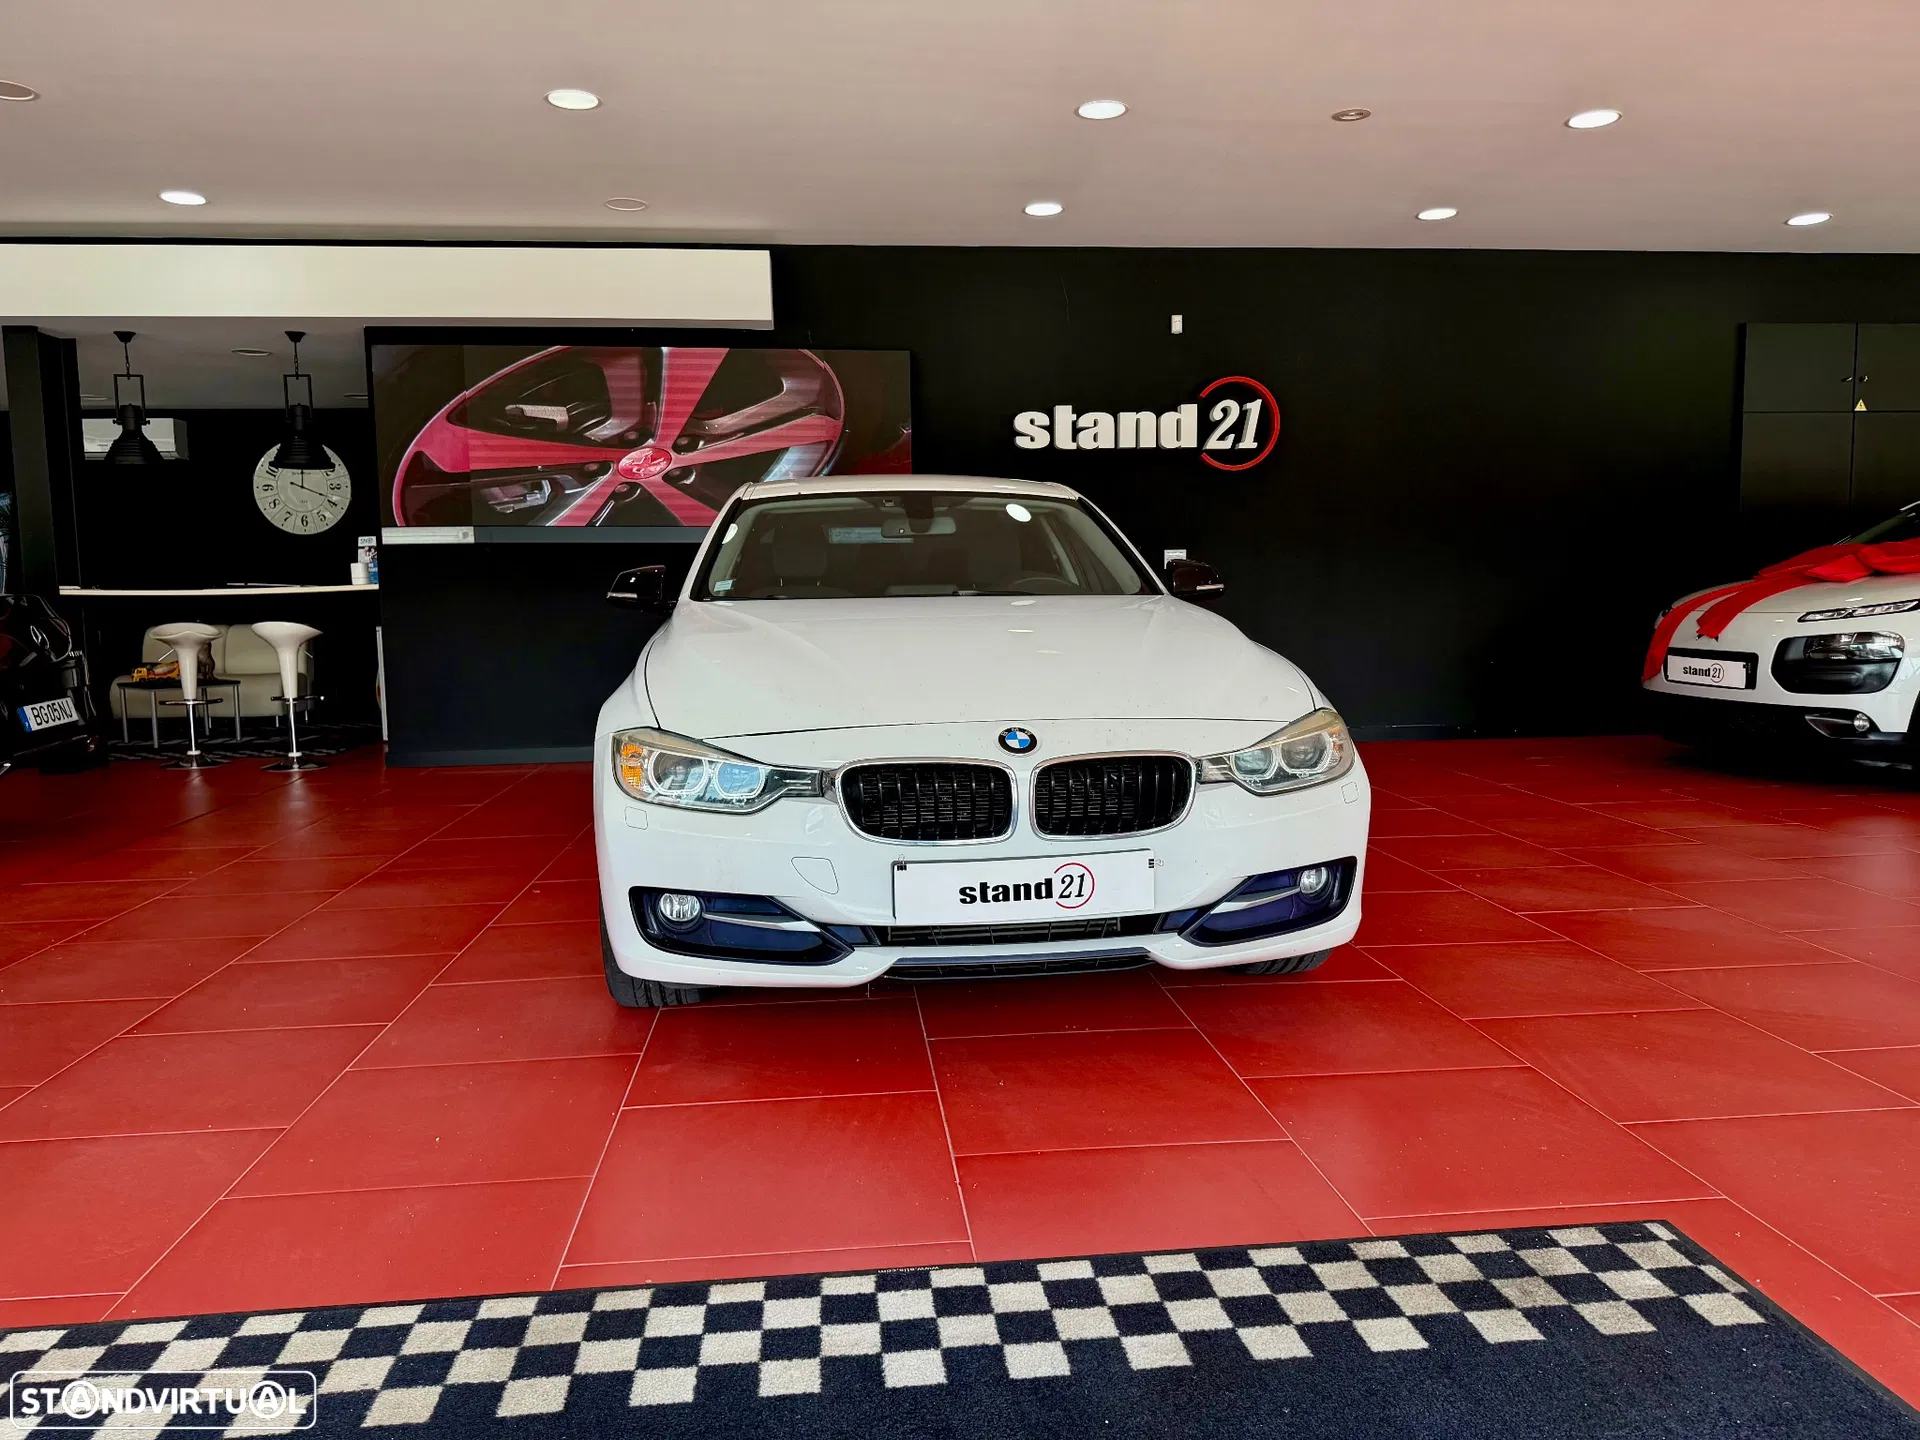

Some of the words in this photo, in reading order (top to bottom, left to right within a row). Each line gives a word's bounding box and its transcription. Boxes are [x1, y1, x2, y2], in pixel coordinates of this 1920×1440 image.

[1013, 403, 1198, 450] stand
[1202, 399, 1263, 451] 21
[262, 483, 274, 492] 9
[329, 483, 342, 491] 3
[269, 498, 281, 510] 8
[327, 499, 338, 509] 4
[283, 510, 293, 522] 7
[300, 514, 309, 528] 6
[316, 509, 327, 522] 5
[1682, 665, 1711, 677] stand
[1711, 667, 1721, 679] 21
[30, 699, 74, 727] BG05NJ
[958, 877, 1054, 905] stand
[1058, 872, 1087, 899] 21
